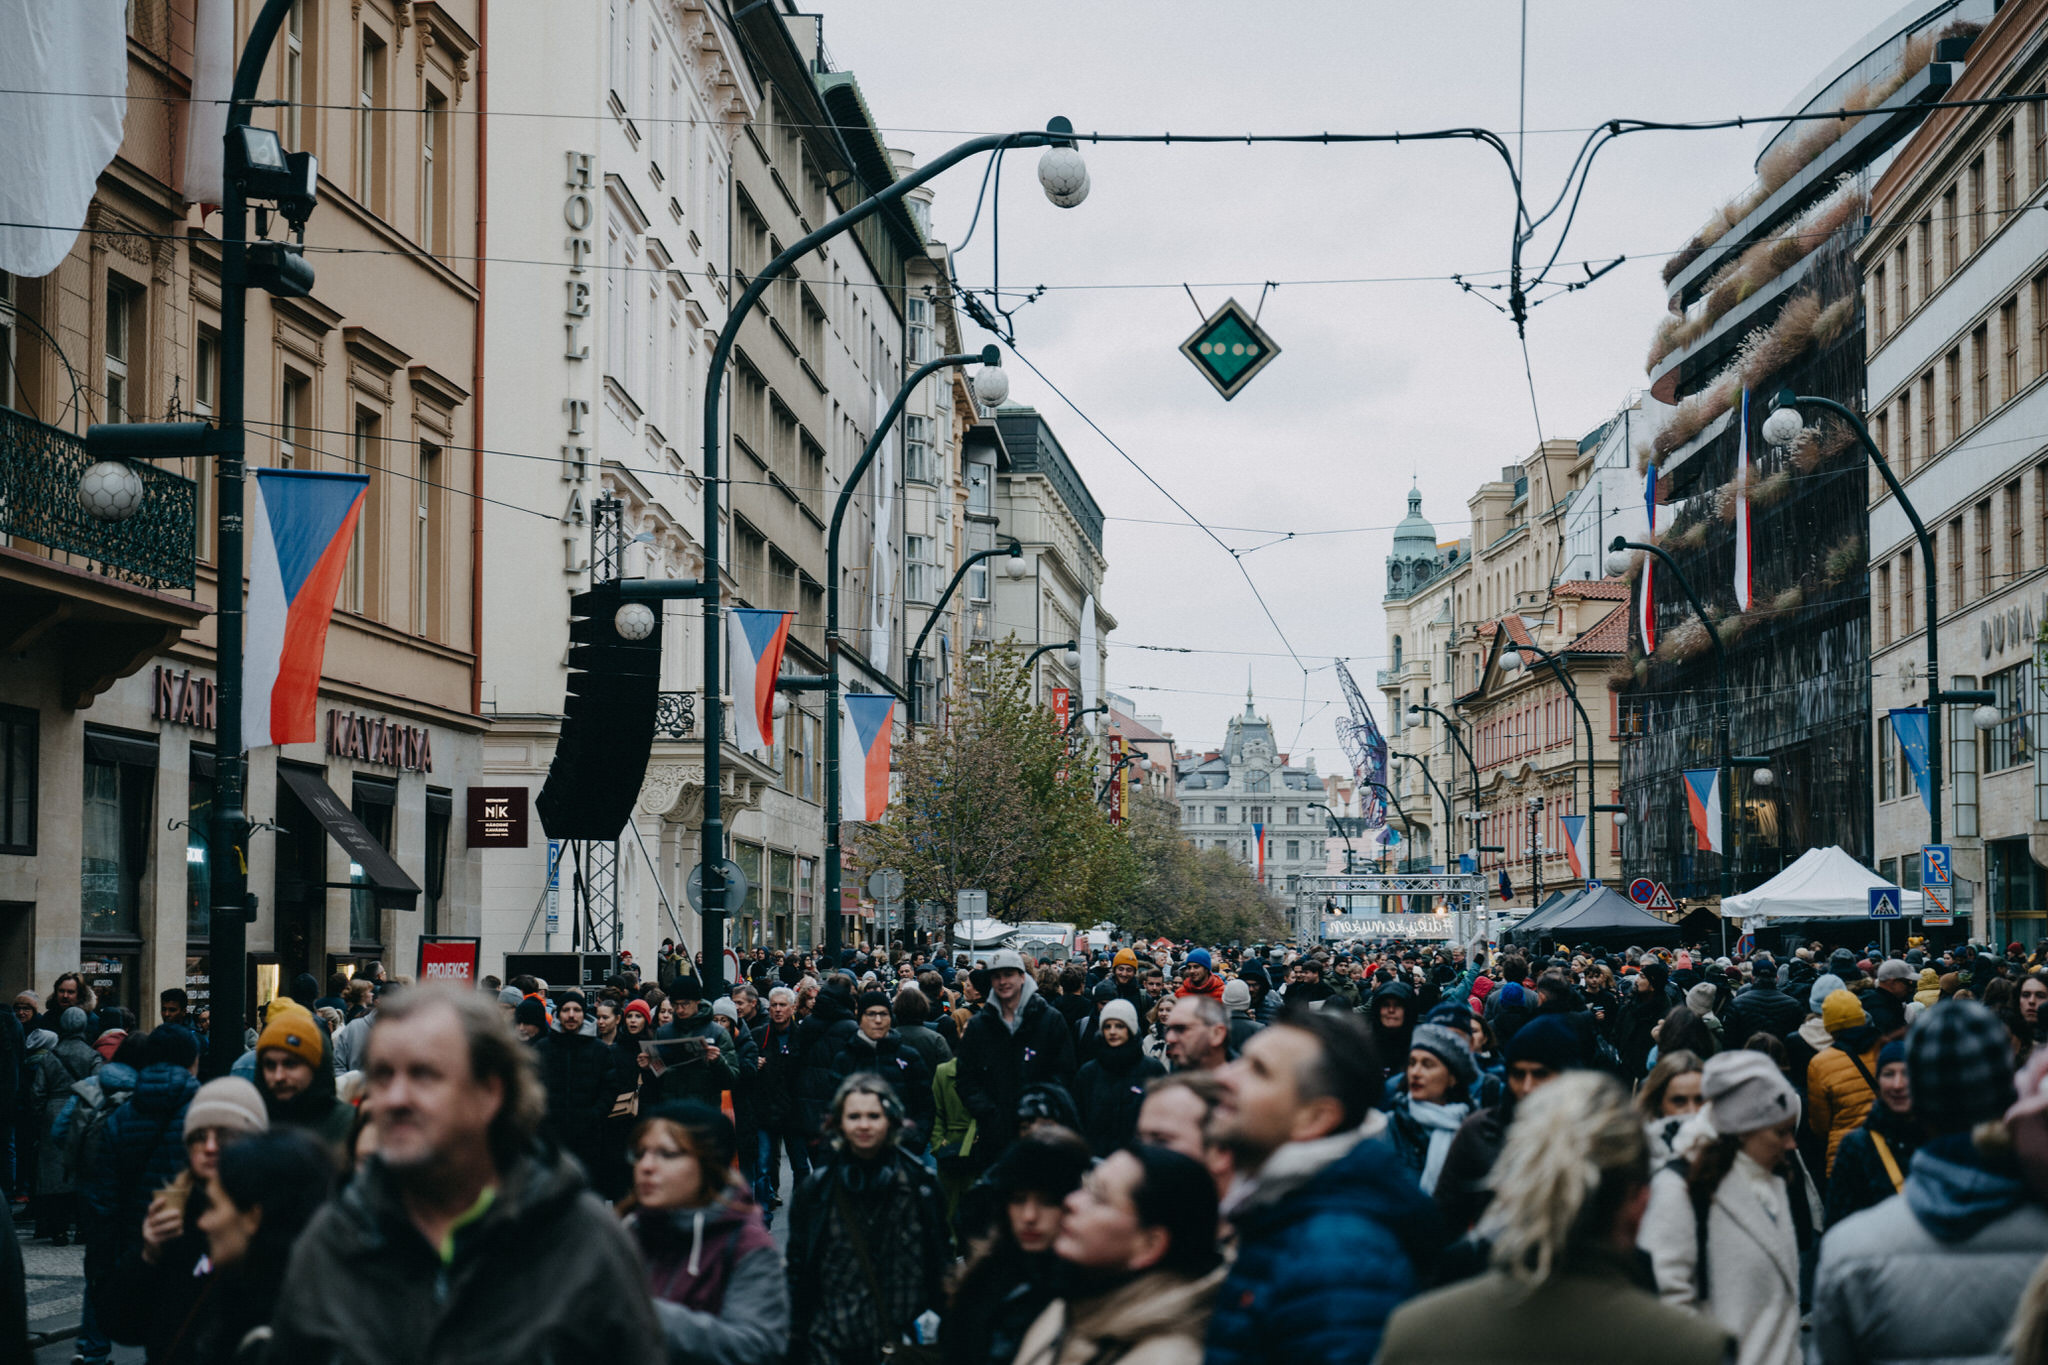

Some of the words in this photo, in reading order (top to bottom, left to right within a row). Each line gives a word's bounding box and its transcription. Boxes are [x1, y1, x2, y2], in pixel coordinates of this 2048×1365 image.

[564, 149, 595, 361] HOTEL
[561, 398, 592, 597] THAL
[426, 962, 470, 979] PROJEKCE
